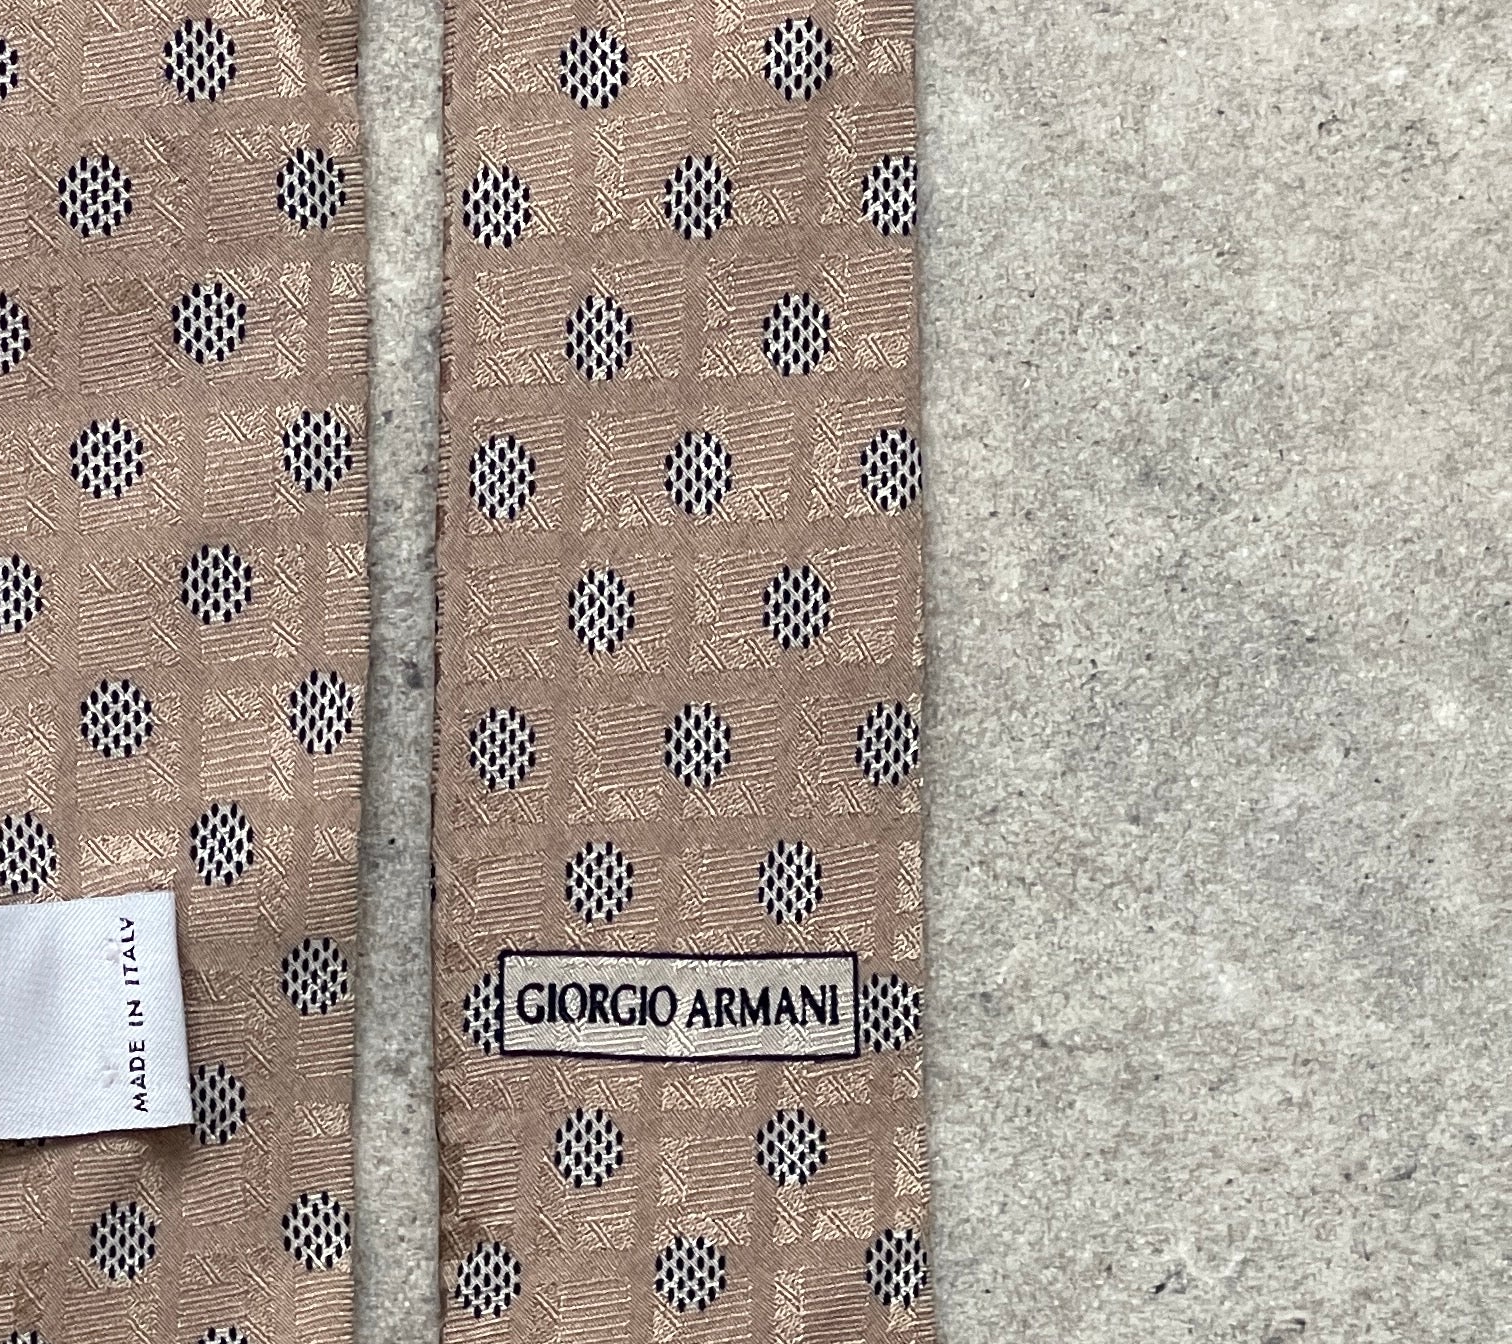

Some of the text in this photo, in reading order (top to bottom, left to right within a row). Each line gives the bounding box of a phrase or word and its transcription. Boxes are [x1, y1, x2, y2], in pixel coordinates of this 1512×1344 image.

[119, 917, 149, 1112] MADE IN ITALY
[516, 981, 840, 1029] GIORGIO ARMANI
